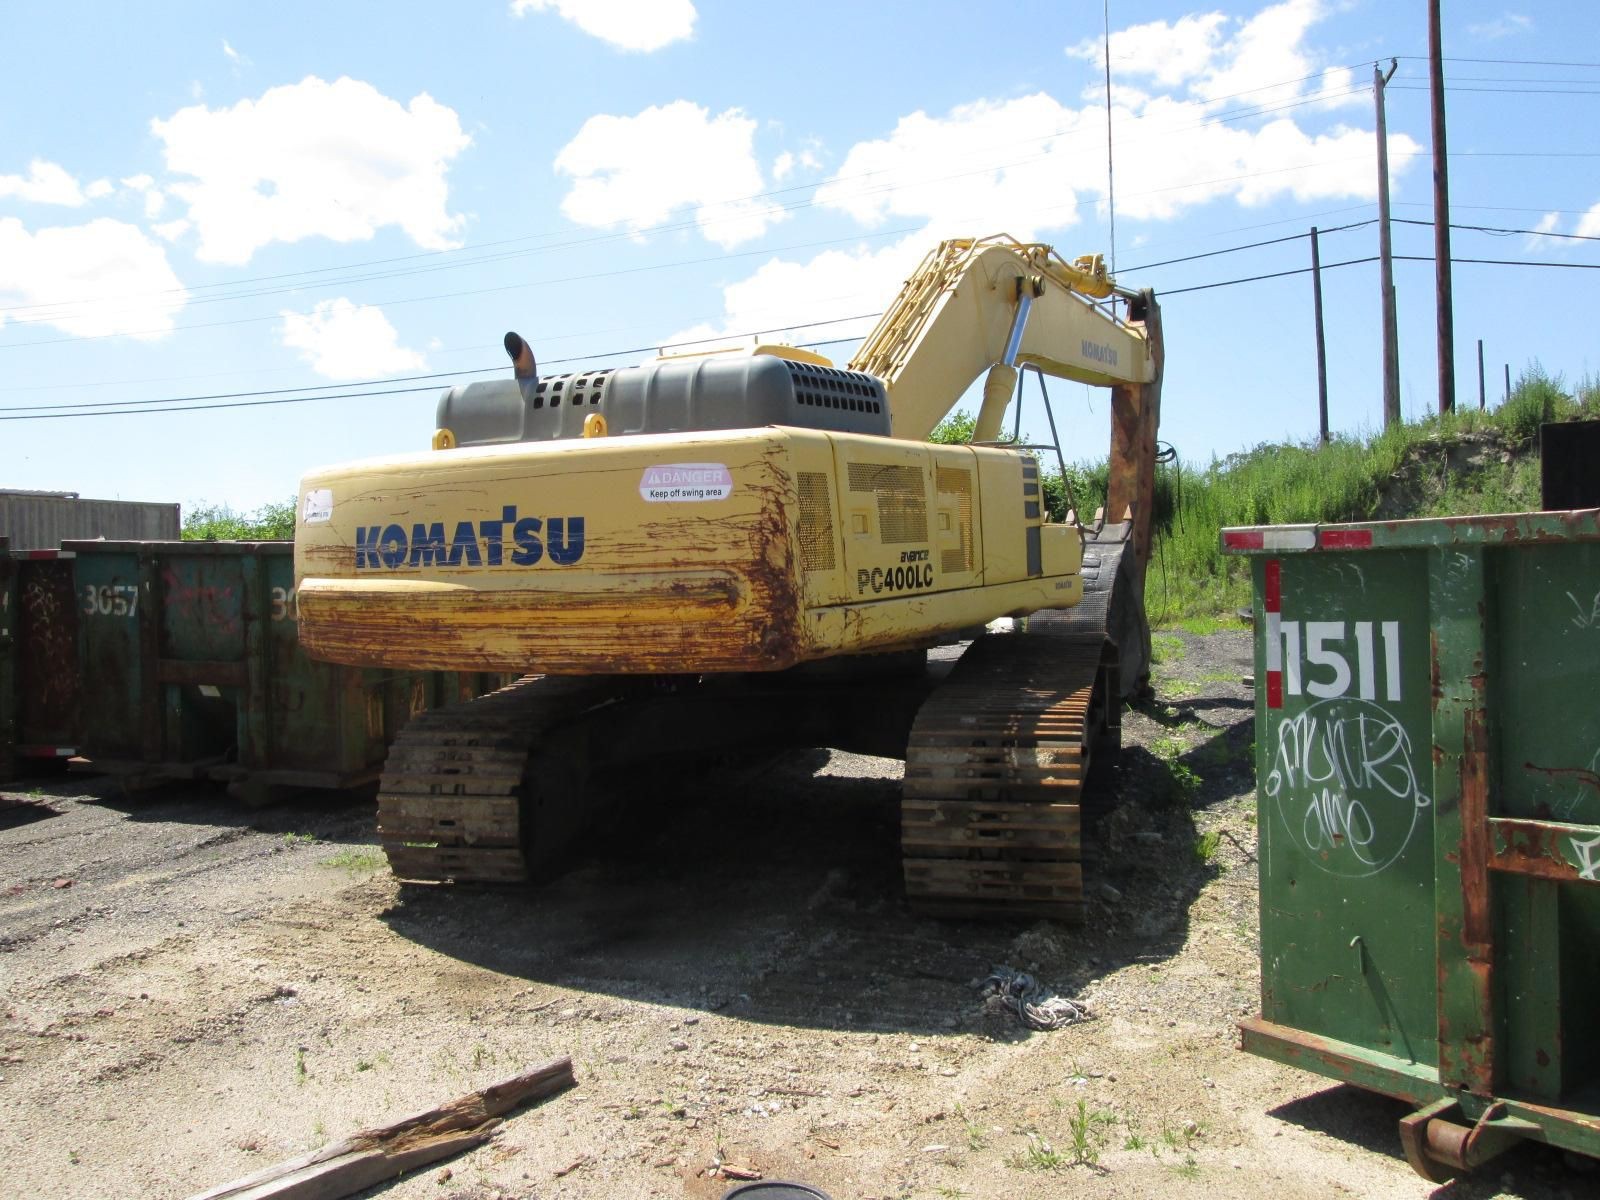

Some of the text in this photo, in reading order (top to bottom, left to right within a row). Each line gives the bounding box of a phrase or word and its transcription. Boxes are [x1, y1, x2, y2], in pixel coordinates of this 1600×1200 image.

[662, 470, 722, 484] DANGER
[650, 490, 668, 499] Keep
[682, 489, 704, 498] swing
[355, 505, 585, 569] KOMATSU
[857, 563, 933, 595] PC400LC
[1280, 620, 1401, 701] 1511
